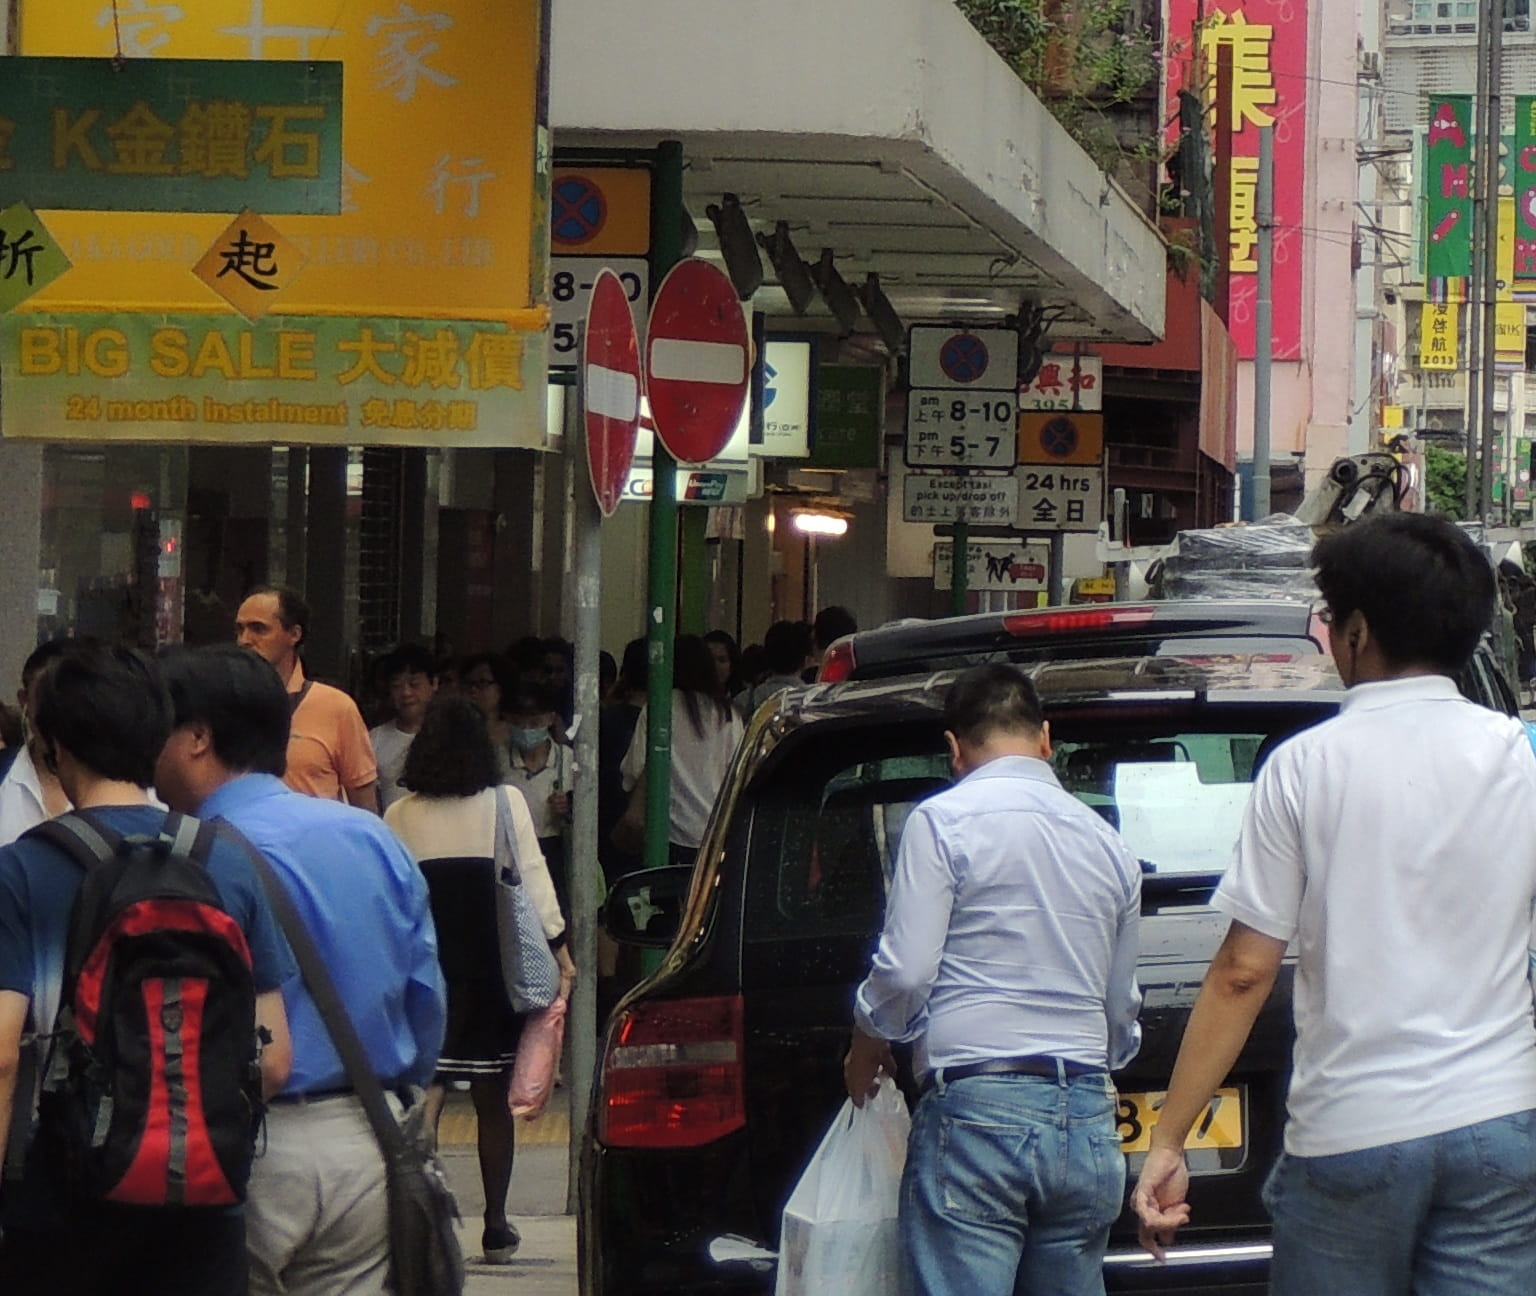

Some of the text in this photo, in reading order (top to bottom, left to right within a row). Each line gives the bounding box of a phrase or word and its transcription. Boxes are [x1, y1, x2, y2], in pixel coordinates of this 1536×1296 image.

[216, 229, 279, 290] 起
[20, 327, 317, 381] BIG SALE
[66, 395, 101, 421] 24
[107, 397, 197, 423] month
[950, 400, 1011, 423] 8-10
[1026, 472, 1090, 492] 24 hrs
[1032, 497, 1084, 522] 全日
